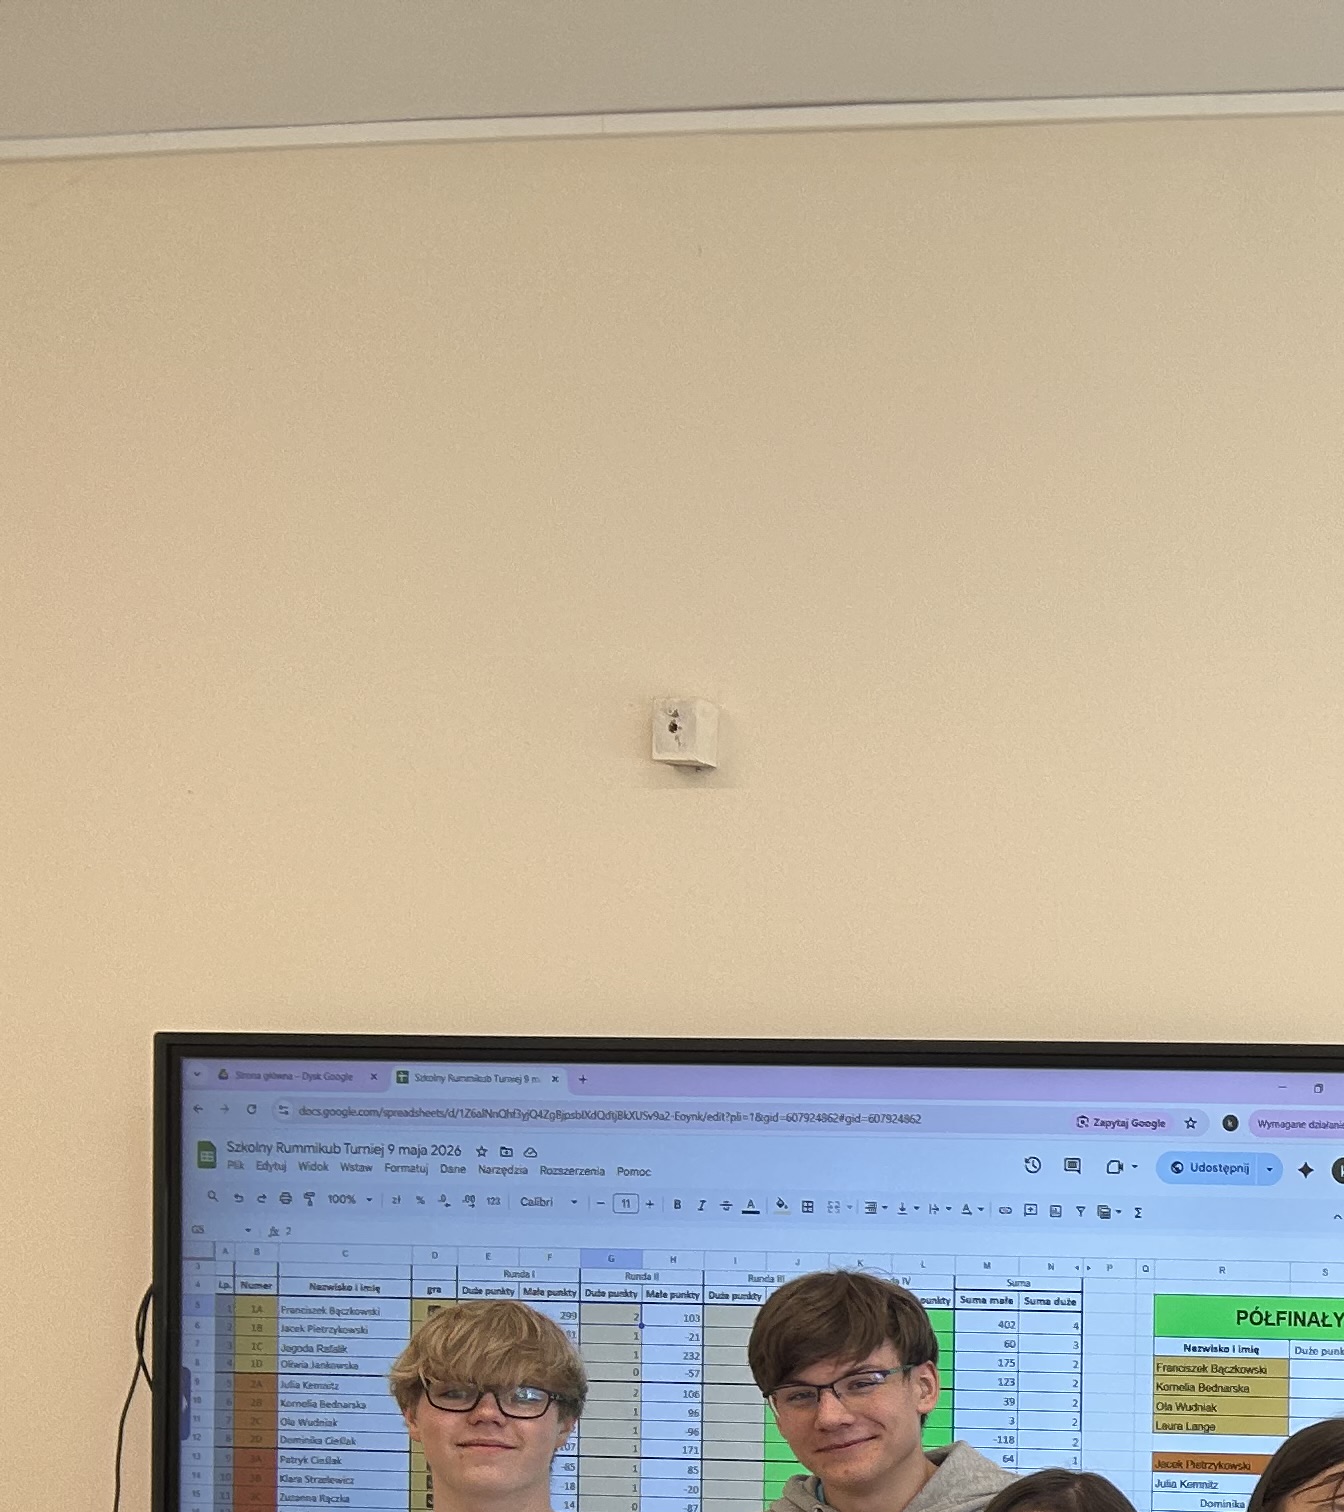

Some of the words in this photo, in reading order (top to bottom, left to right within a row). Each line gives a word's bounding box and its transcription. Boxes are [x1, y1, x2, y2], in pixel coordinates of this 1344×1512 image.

[1093, 1117, 1128, 1130] Zapytaj
[1132, 1118, 1166, 1130] Google
[1258, 1119, 1305, 1132] Wymagane
[227, 1141, 272, 1155] Szkolny
[276, 1141, 340, 1154] Rummikub
[344, 1143, 384, 1158] Turniej
[387, 1144, 395, 1155] 9
[398, 1146, 428, 1158] maja
[431, 1144, 462, 1156] 2026
[384, 1163, 428, 1175] Formatuj
[440, 1164, 466, 1173] Dane
[616, 1167, 652, 1177] Pomoc
[1190, 1161, 1250, 1177] Udostępnij
[1007, 1279, 1031, 1288] Suma
[683, 1351, 700, 1360] 232
